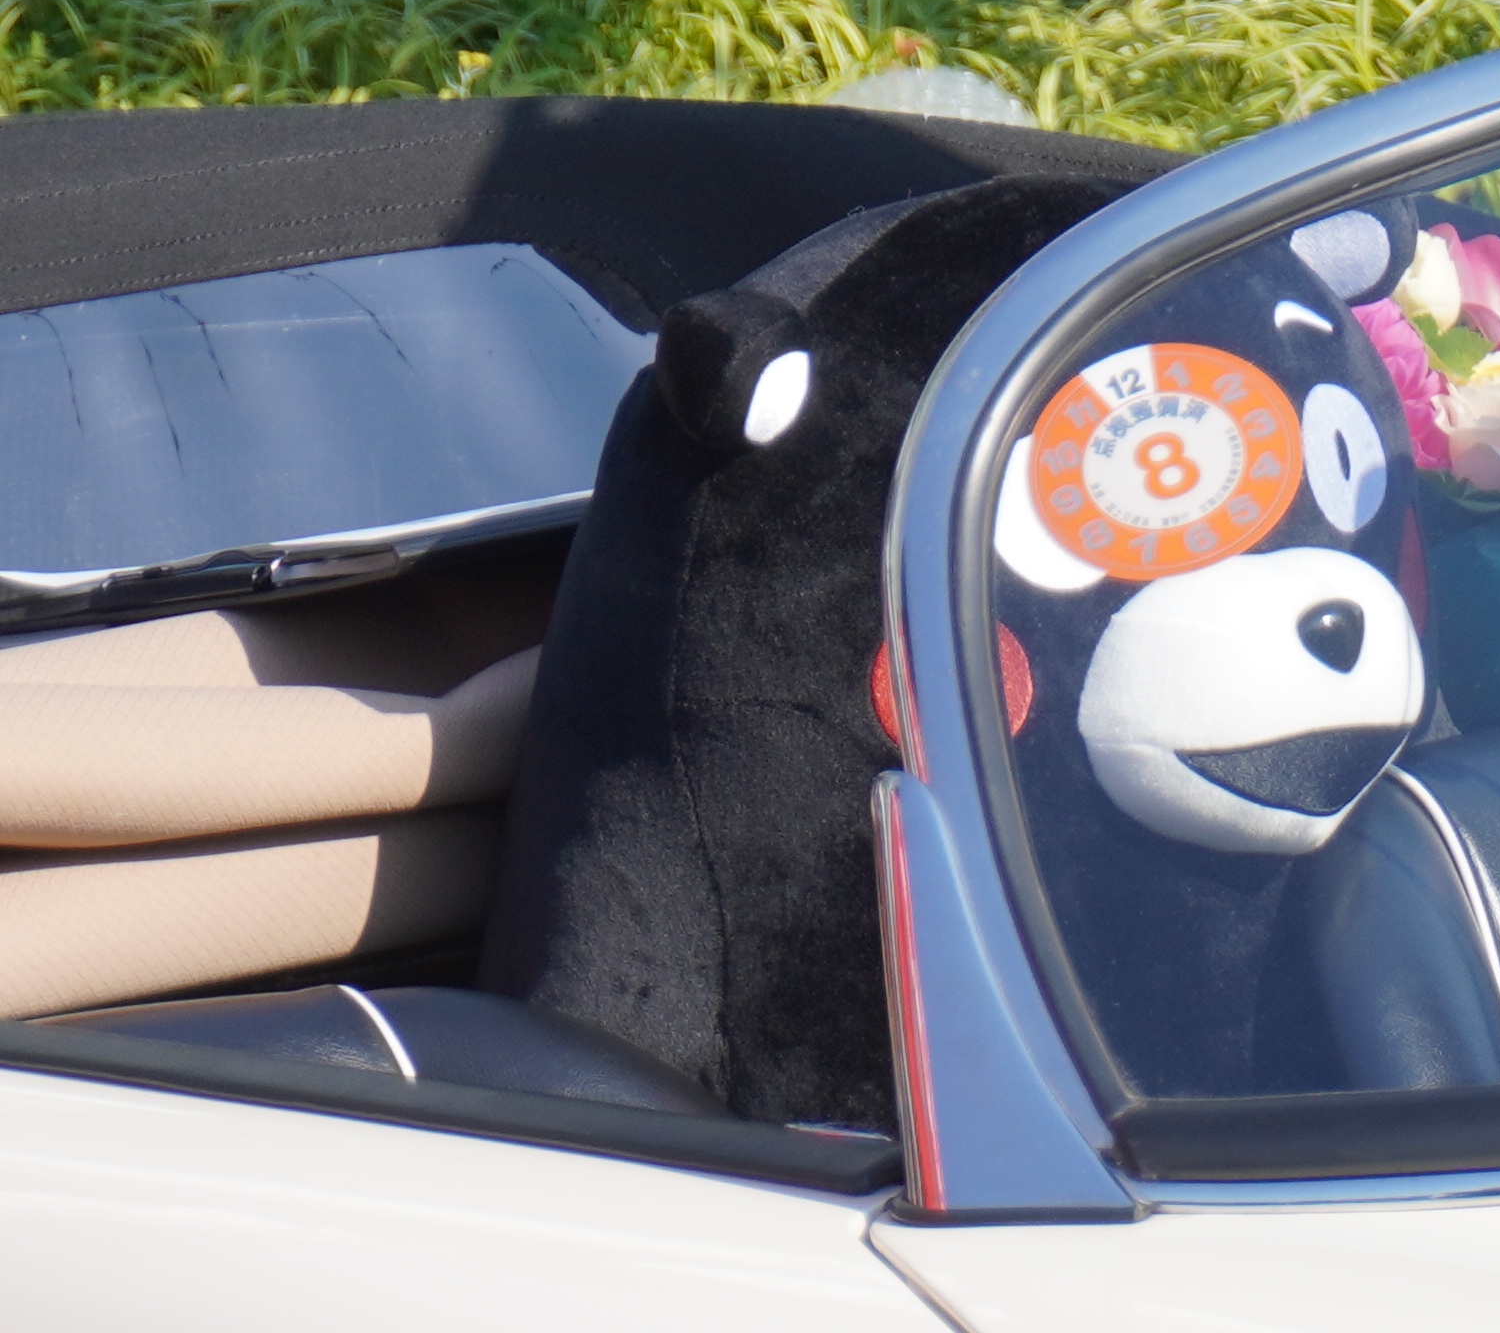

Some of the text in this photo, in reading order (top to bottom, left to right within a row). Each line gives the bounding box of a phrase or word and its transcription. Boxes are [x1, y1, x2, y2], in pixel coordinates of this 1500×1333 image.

[1106, 369, 1146, 399] 12
[1167, 361, 1188, 387] 1
[1212, 372, 1250, 404] 2
[1066, 399, 1100, 428] 11
[1242, 409, 1277, 438] 3
[1043, 442, 1081, 474] 10
[1133, 431, 1200, 499] 8
[1253, 451, 1281, 479] 4
[1050, 485, 1085, 516] 9
[1226, 495, 1262, 525] 5
[1078, 519, 1115, 551] 8
[1128, 534, 1160, 564] 7
[1183, 523, 1220, 554] 6
